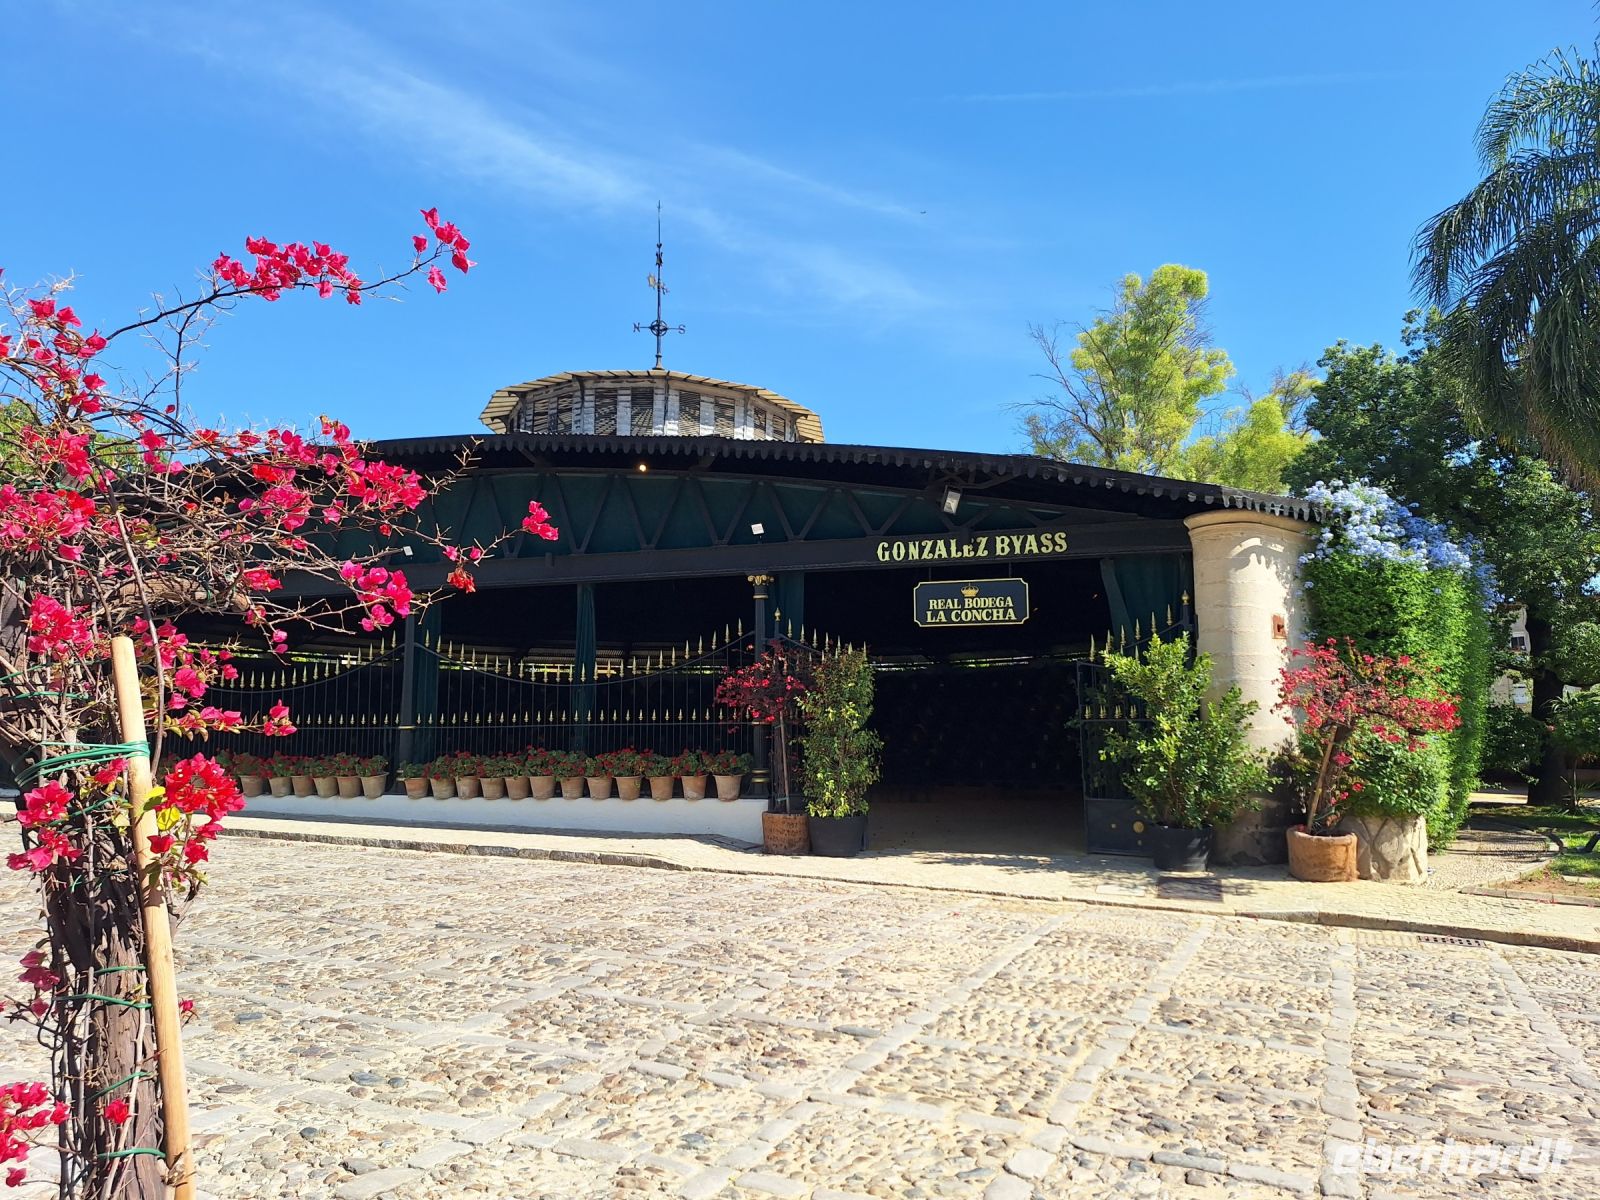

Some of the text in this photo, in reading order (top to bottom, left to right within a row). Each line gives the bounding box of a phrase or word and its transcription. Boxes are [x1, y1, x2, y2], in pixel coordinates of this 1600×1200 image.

[995, 532, 1068, 556] BYASS
[929, 596, 1014, 610] REAL BODEGA
[926, 607, 1017, 623] LA CONCHA
